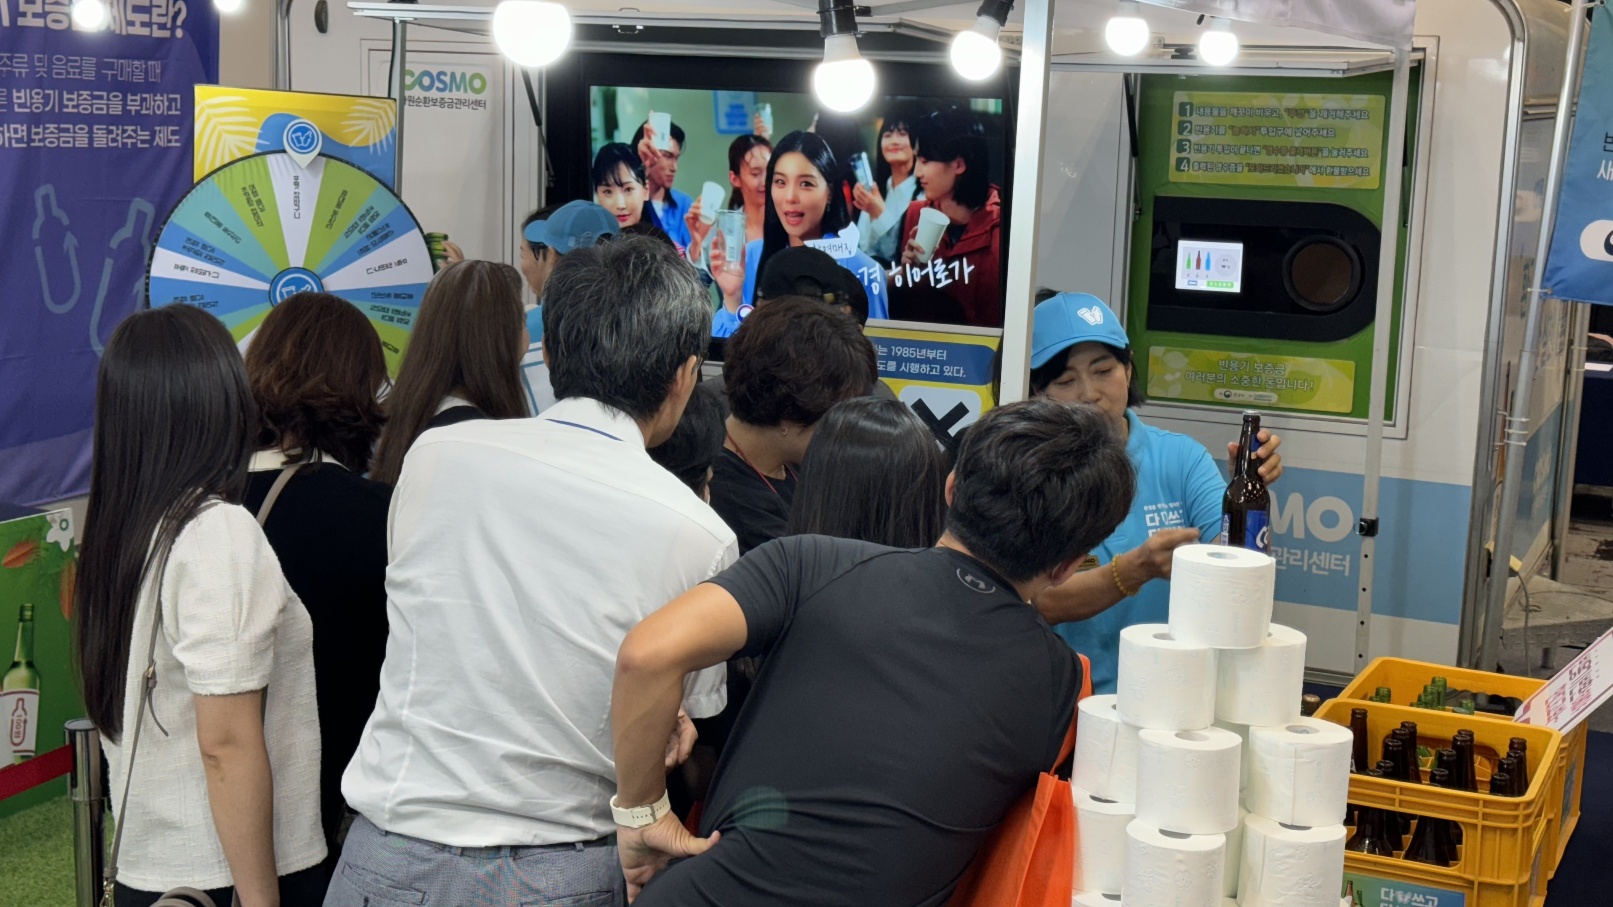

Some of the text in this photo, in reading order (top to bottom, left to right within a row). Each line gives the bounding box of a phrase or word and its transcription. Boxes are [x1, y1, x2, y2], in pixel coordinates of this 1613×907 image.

[17, 0, 104, 31] 보증
[34, 54, 48, 78] 및
[52, 55, 96, 80] 음료를
[101, 57, 146, 82] 구매할
[148, 60, 161, 82] 때
[13, 89, 59, 113] 빈용기
[63, 90, 122, 115] 보증금을
[126, 93, 181, 115] 부과하고
[404, 95, 486, 110] 원순환보증금관리센터
[30, 124, 89, 148] 보증금을
[93, 125, 151, 149] 돌려주는
[154, 126, 181, 147] 제도
[888, 257, 975, 289] 히어로가
[891, 346, 947, 361] 1985년부터
[899, 362, 940, 375] 시행하고
[943, 365, 966, 378] 있다.
[1218, 359, 1286, 375] 빈용기 보증금
[1185, 371, 1314, 392] 여러분의 소중한 돈입니다!
